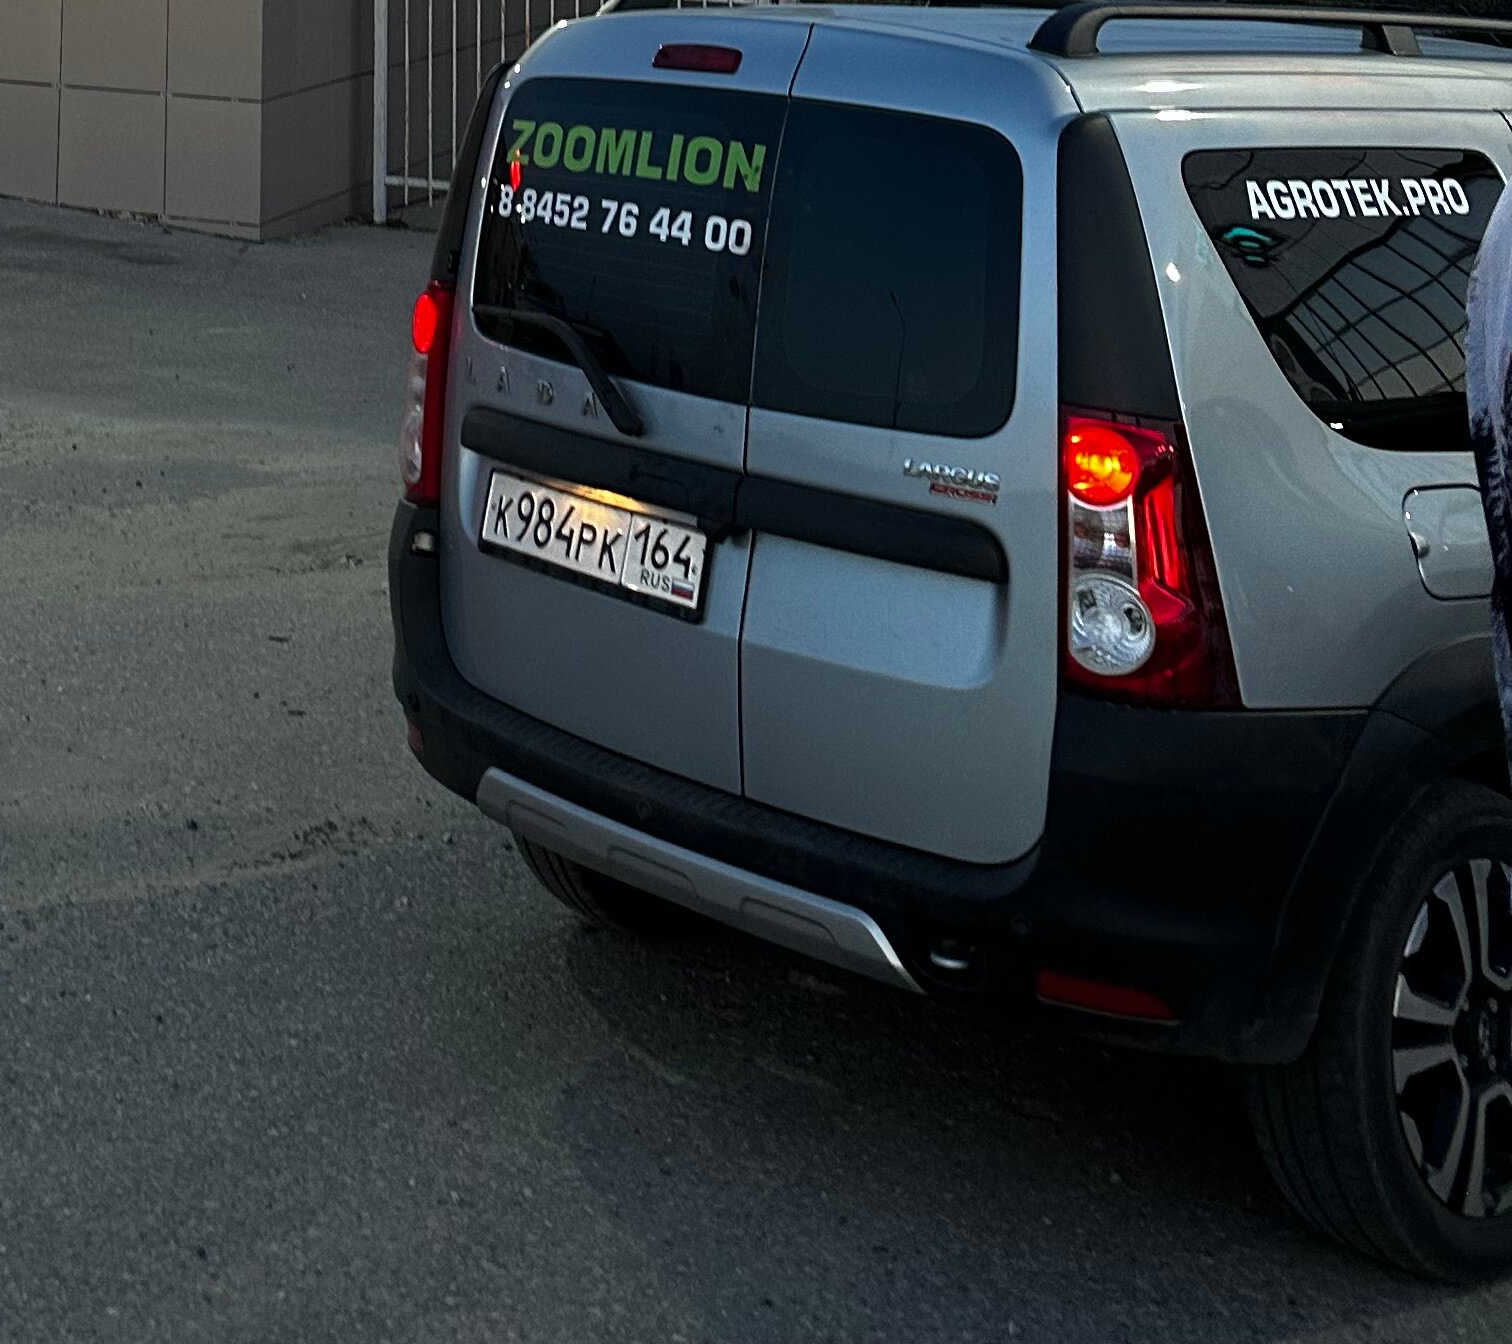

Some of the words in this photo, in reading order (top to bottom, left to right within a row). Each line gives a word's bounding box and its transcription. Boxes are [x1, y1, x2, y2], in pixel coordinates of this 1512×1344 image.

[506, 119, 766, 193] ZOOMLION
[601, 199, 639, 237] 76
[649, 207, 693, 246] 44
[704, 215, 752, 256] 00
[1245, 178, 1470, 220] AGROTEK.PRO
[635, 522, 692, 579] 164
[639, 568, 671, 593] RUS
